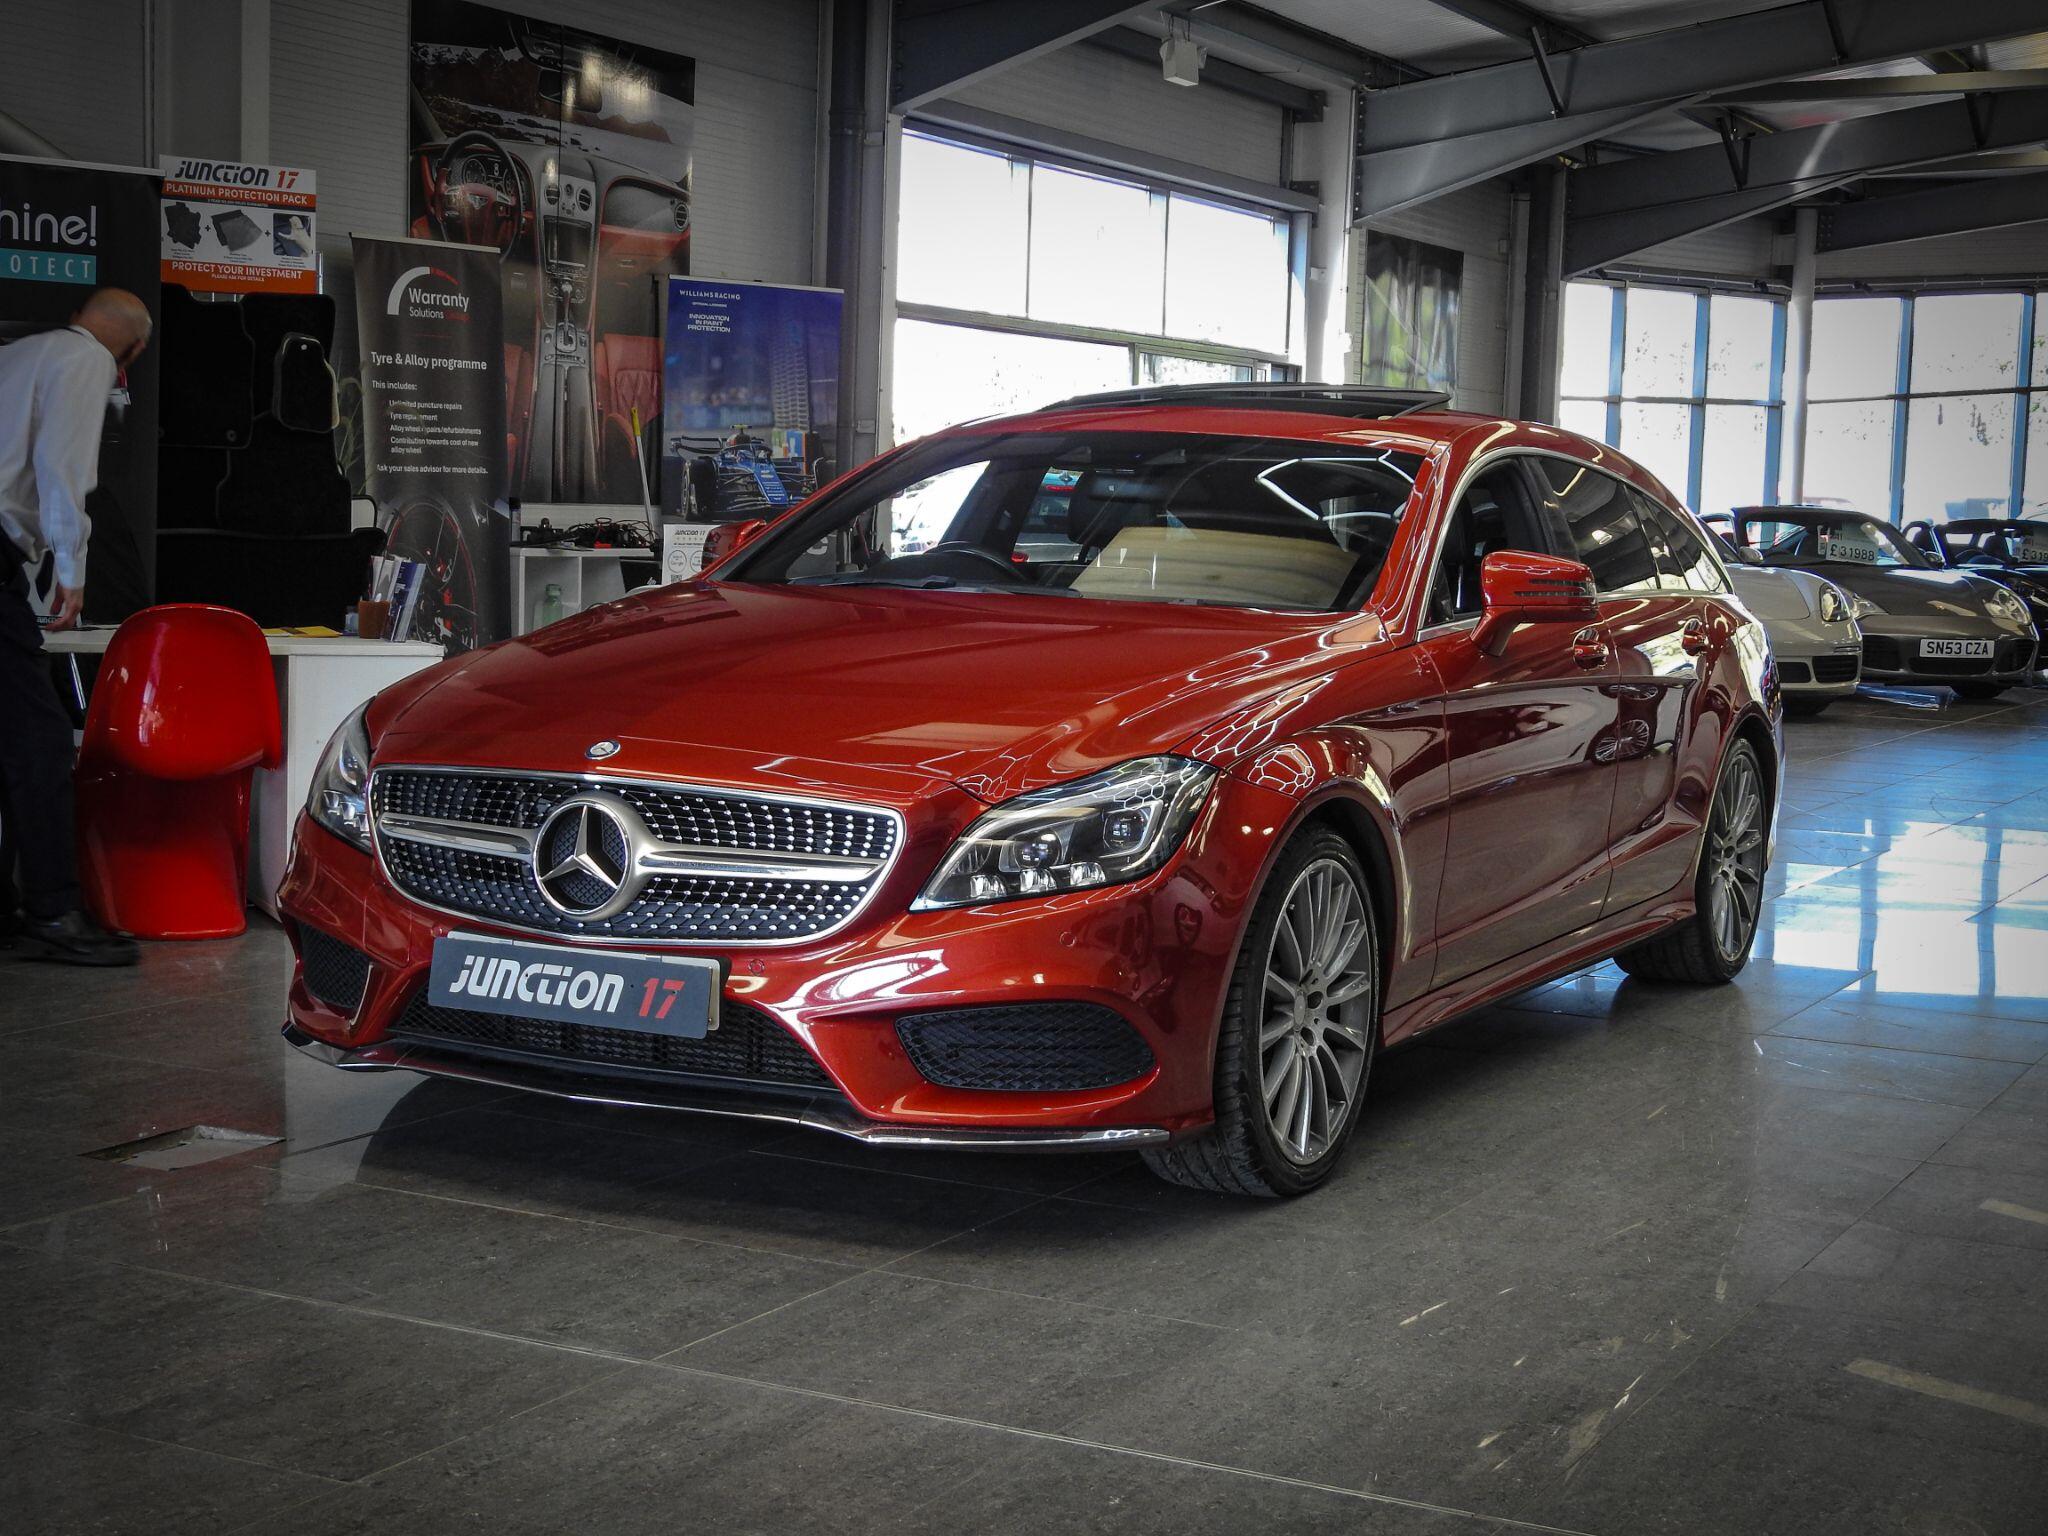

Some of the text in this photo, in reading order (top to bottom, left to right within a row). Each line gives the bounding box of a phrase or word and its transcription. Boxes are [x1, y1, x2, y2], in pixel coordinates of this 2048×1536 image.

[276, 170, 300, 189] 17
[165, 183, 217, 197] PLATINUM
[218, 189, 281, 203] PROTECTION
[282, 194, 309, 205] PACK
[171, 261, 304, 280] PROTECT YOUR INVESTMENT
[408, 287, 470, 312] Warranty
[679, 289, 741, 300] WILLIAMS RACING
[409, 306, 444, 319] Solutions
[688, 313, 730, 322] INNOVATION
[687, 325, 731, 333] PROTECTION
[371, 351, 487, 371] Tyre & Alloy programme
[372, 380, 417, 391] This includes:
[417, 402, 443, 411] puncture
[443, 402, 462, 412] repairs
[390, 425, 404, 434] Alloy
[426, 438, 449, 446] towards
[388, 465, 403, 474] your
[403, 465, 419, 473] sales
[419, 465, 443, 473] advisor
[442, 465, 452, 473] for
[1926, 641, 1989, 656] SN53 CZA
[638, 978, 686, 1019] 17
